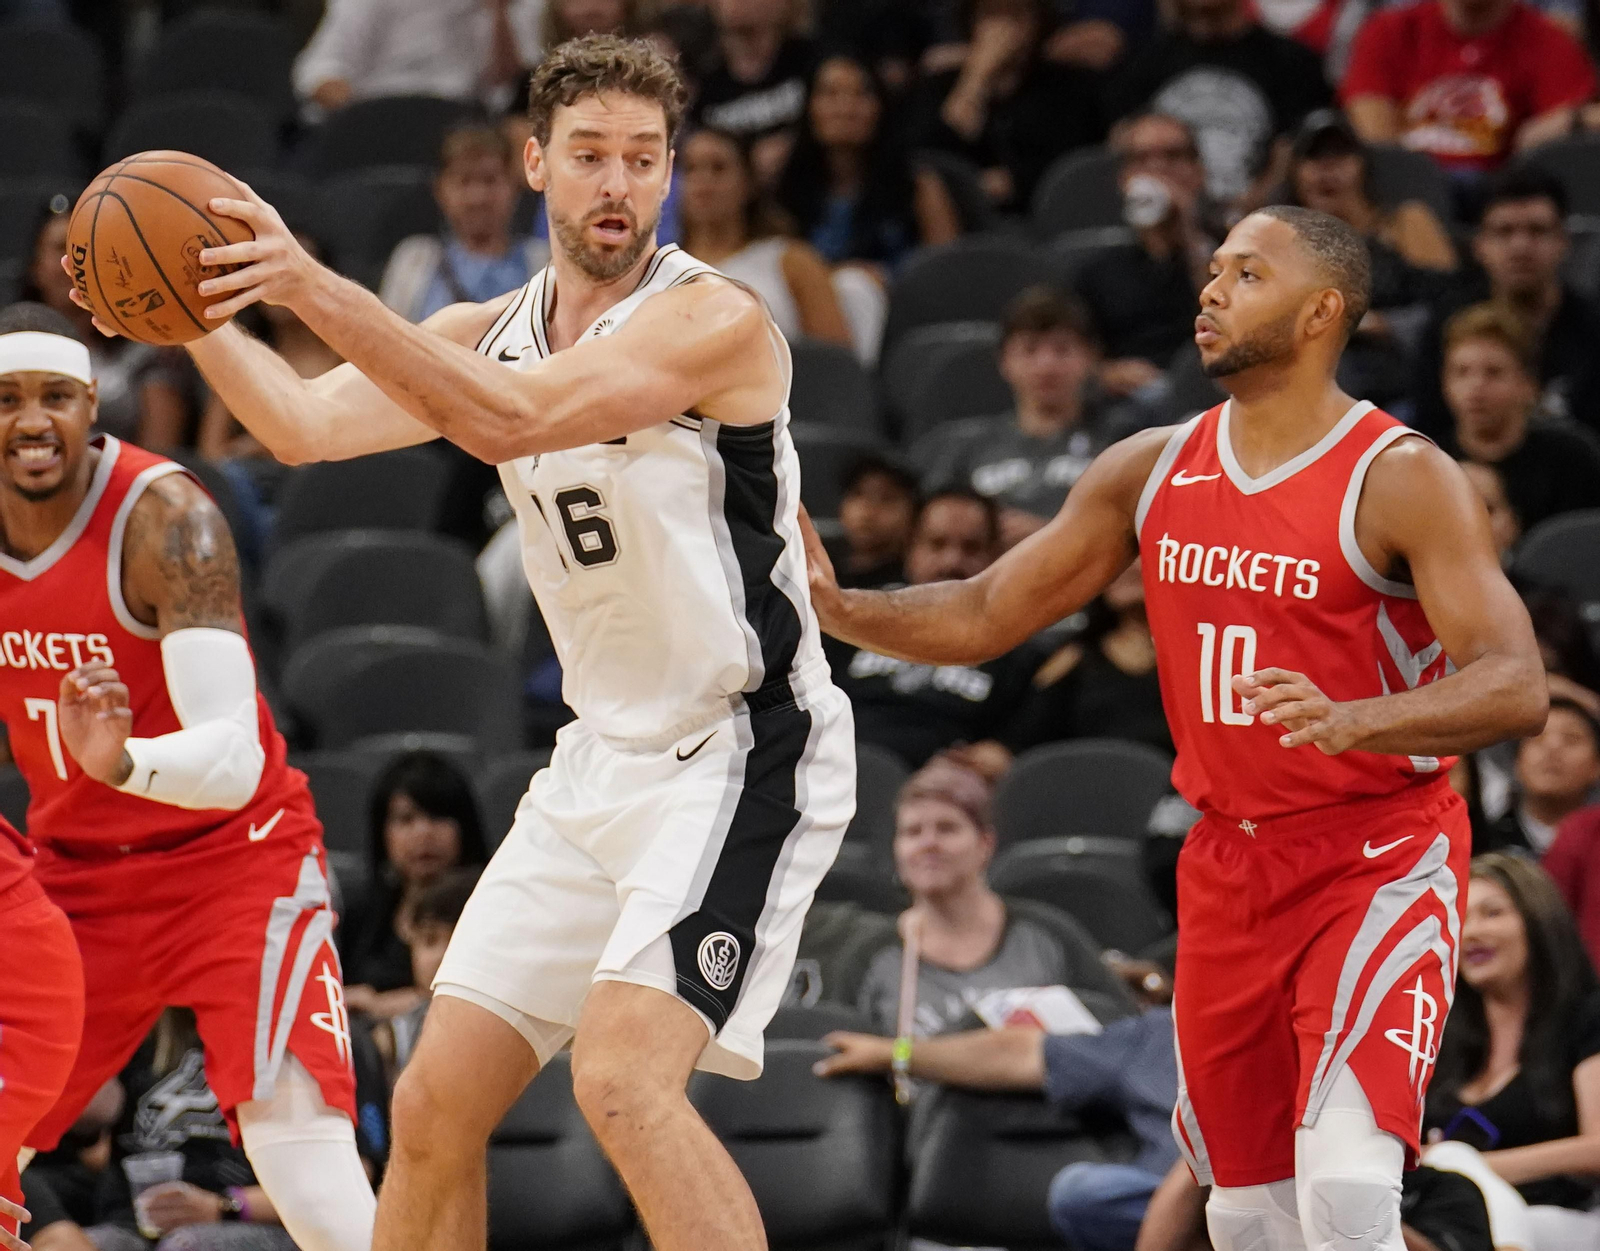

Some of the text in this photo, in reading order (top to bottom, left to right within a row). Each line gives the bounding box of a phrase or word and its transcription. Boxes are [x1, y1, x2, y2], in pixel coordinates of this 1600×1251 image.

[1156, 532, 1321, 600] ROCKETS
[1197, 622, 1257, 726] 10
[24, 697, 68, 781] 7
